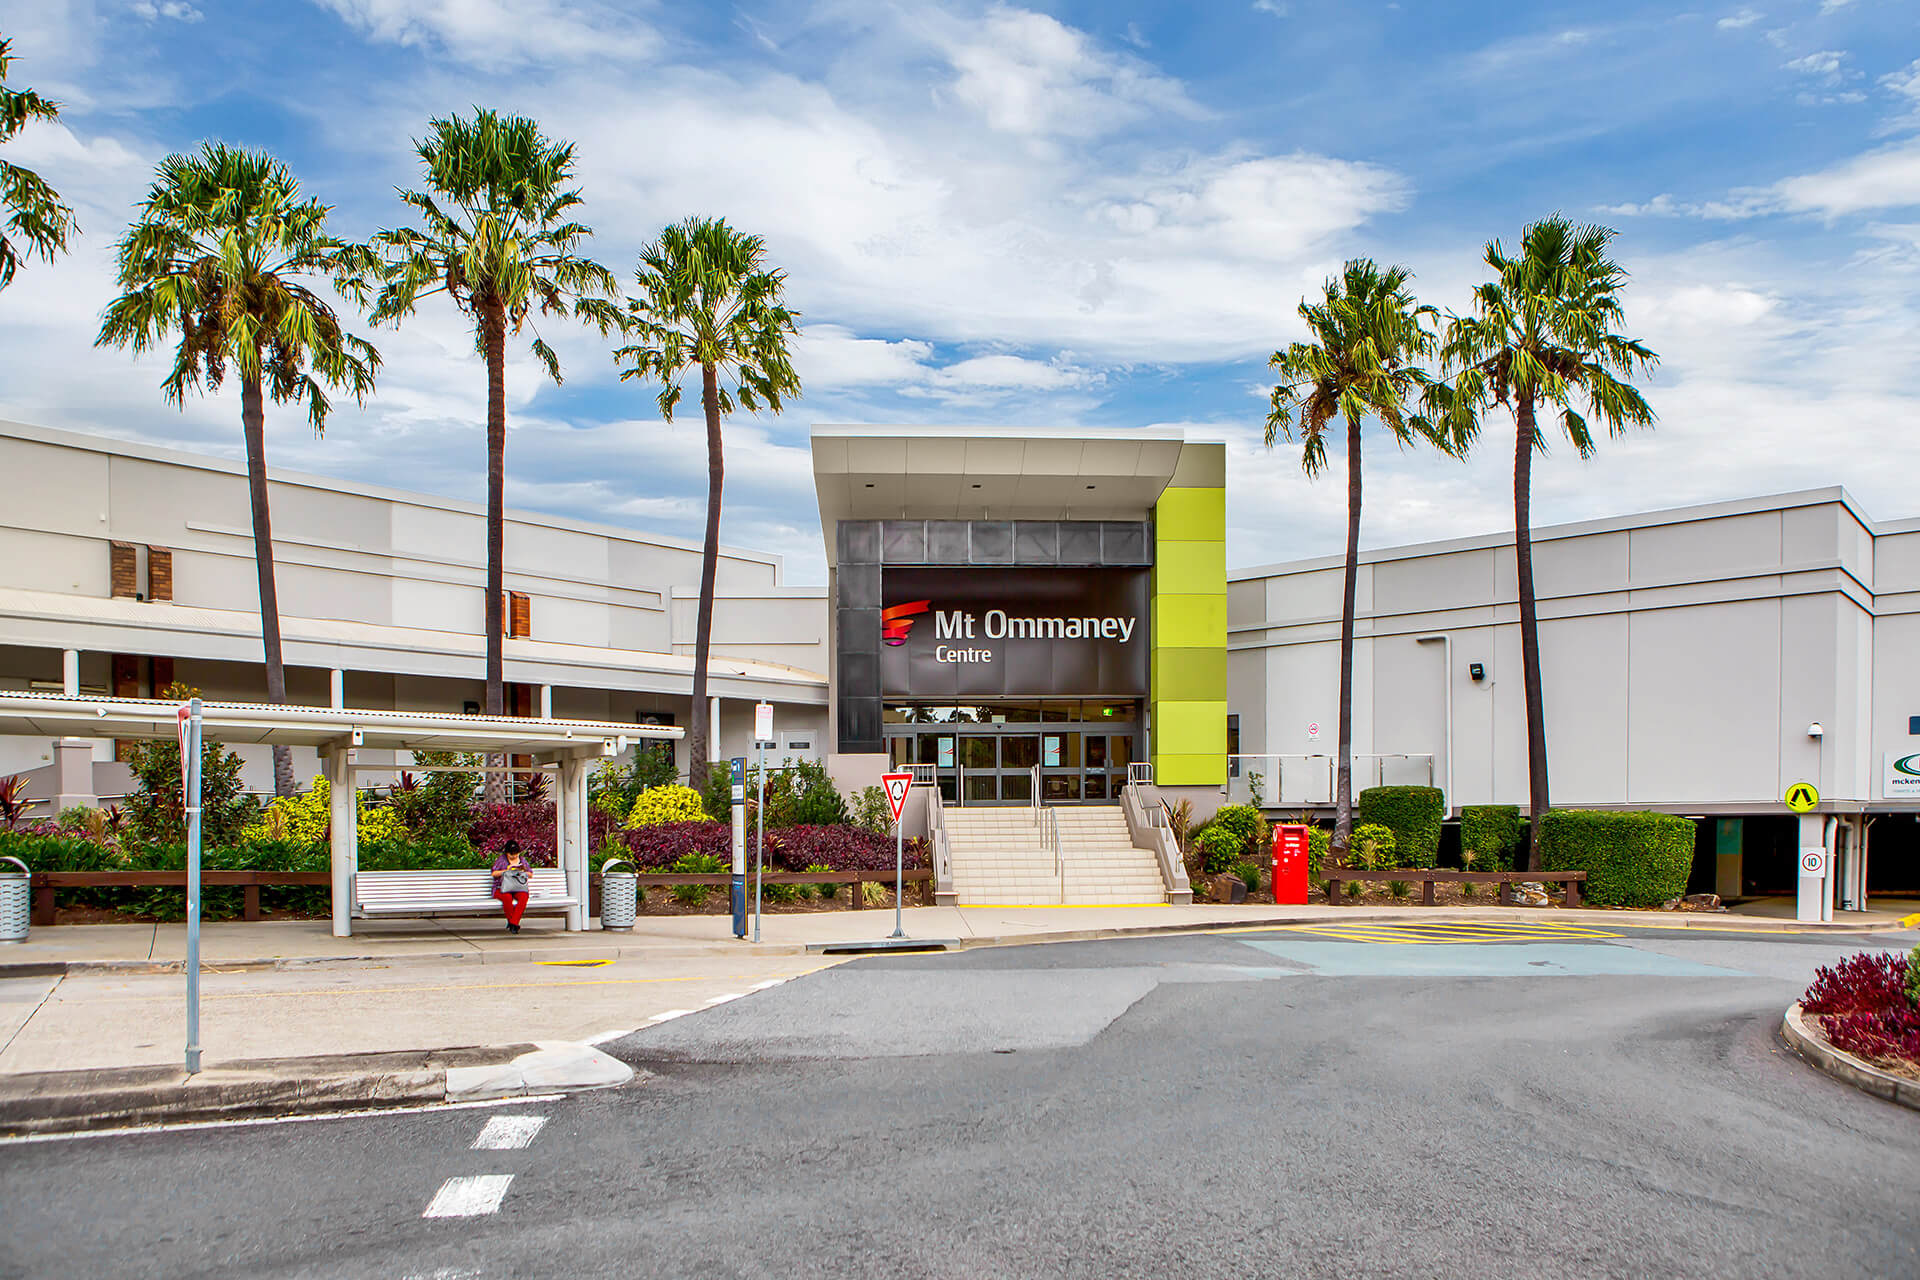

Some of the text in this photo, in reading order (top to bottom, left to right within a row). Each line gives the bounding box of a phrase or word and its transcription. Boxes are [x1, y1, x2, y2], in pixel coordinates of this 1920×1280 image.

[935, 609, 1136, 643] Mt Ommaney
[935, 645, 992, 663] Centre
[1807, 857, 1817, 867] 10
